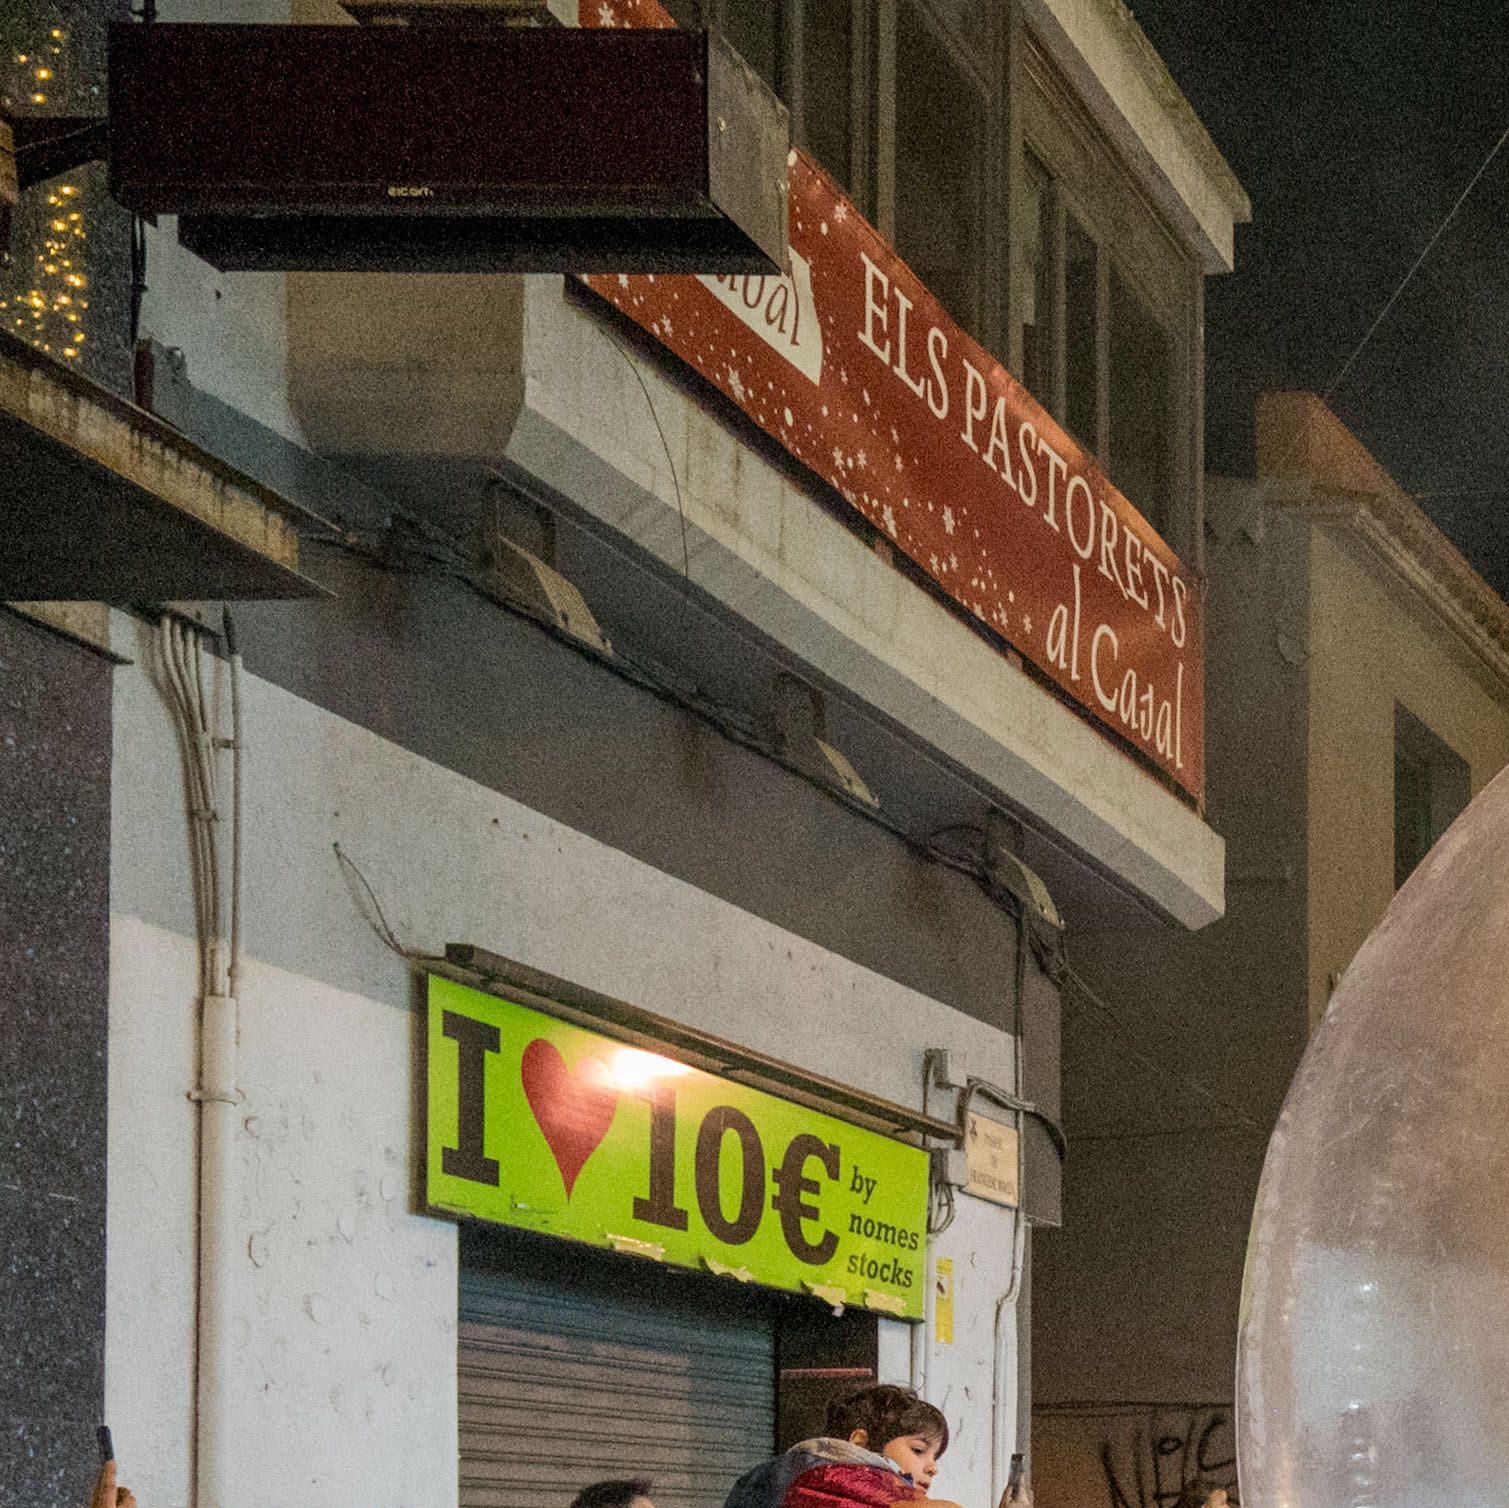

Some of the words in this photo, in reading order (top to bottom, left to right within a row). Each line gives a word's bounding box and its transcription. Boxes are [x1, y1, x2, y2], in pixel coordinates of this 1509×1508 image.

[858, 251, 948, 420] ELS
[961, 359, 1186, 648] PASTORETS
[1046, 563, 1081, 680] al
[1091, 624, 1184, 769] Casal
[442, 1010, 500, 1187] I
[633, 1087, 840, 1266] 10€
[850, 1165, 878, 1204] by
[847, 1253, 913, 1288] stocks
[849, 1213, 919, 1250] nomes
